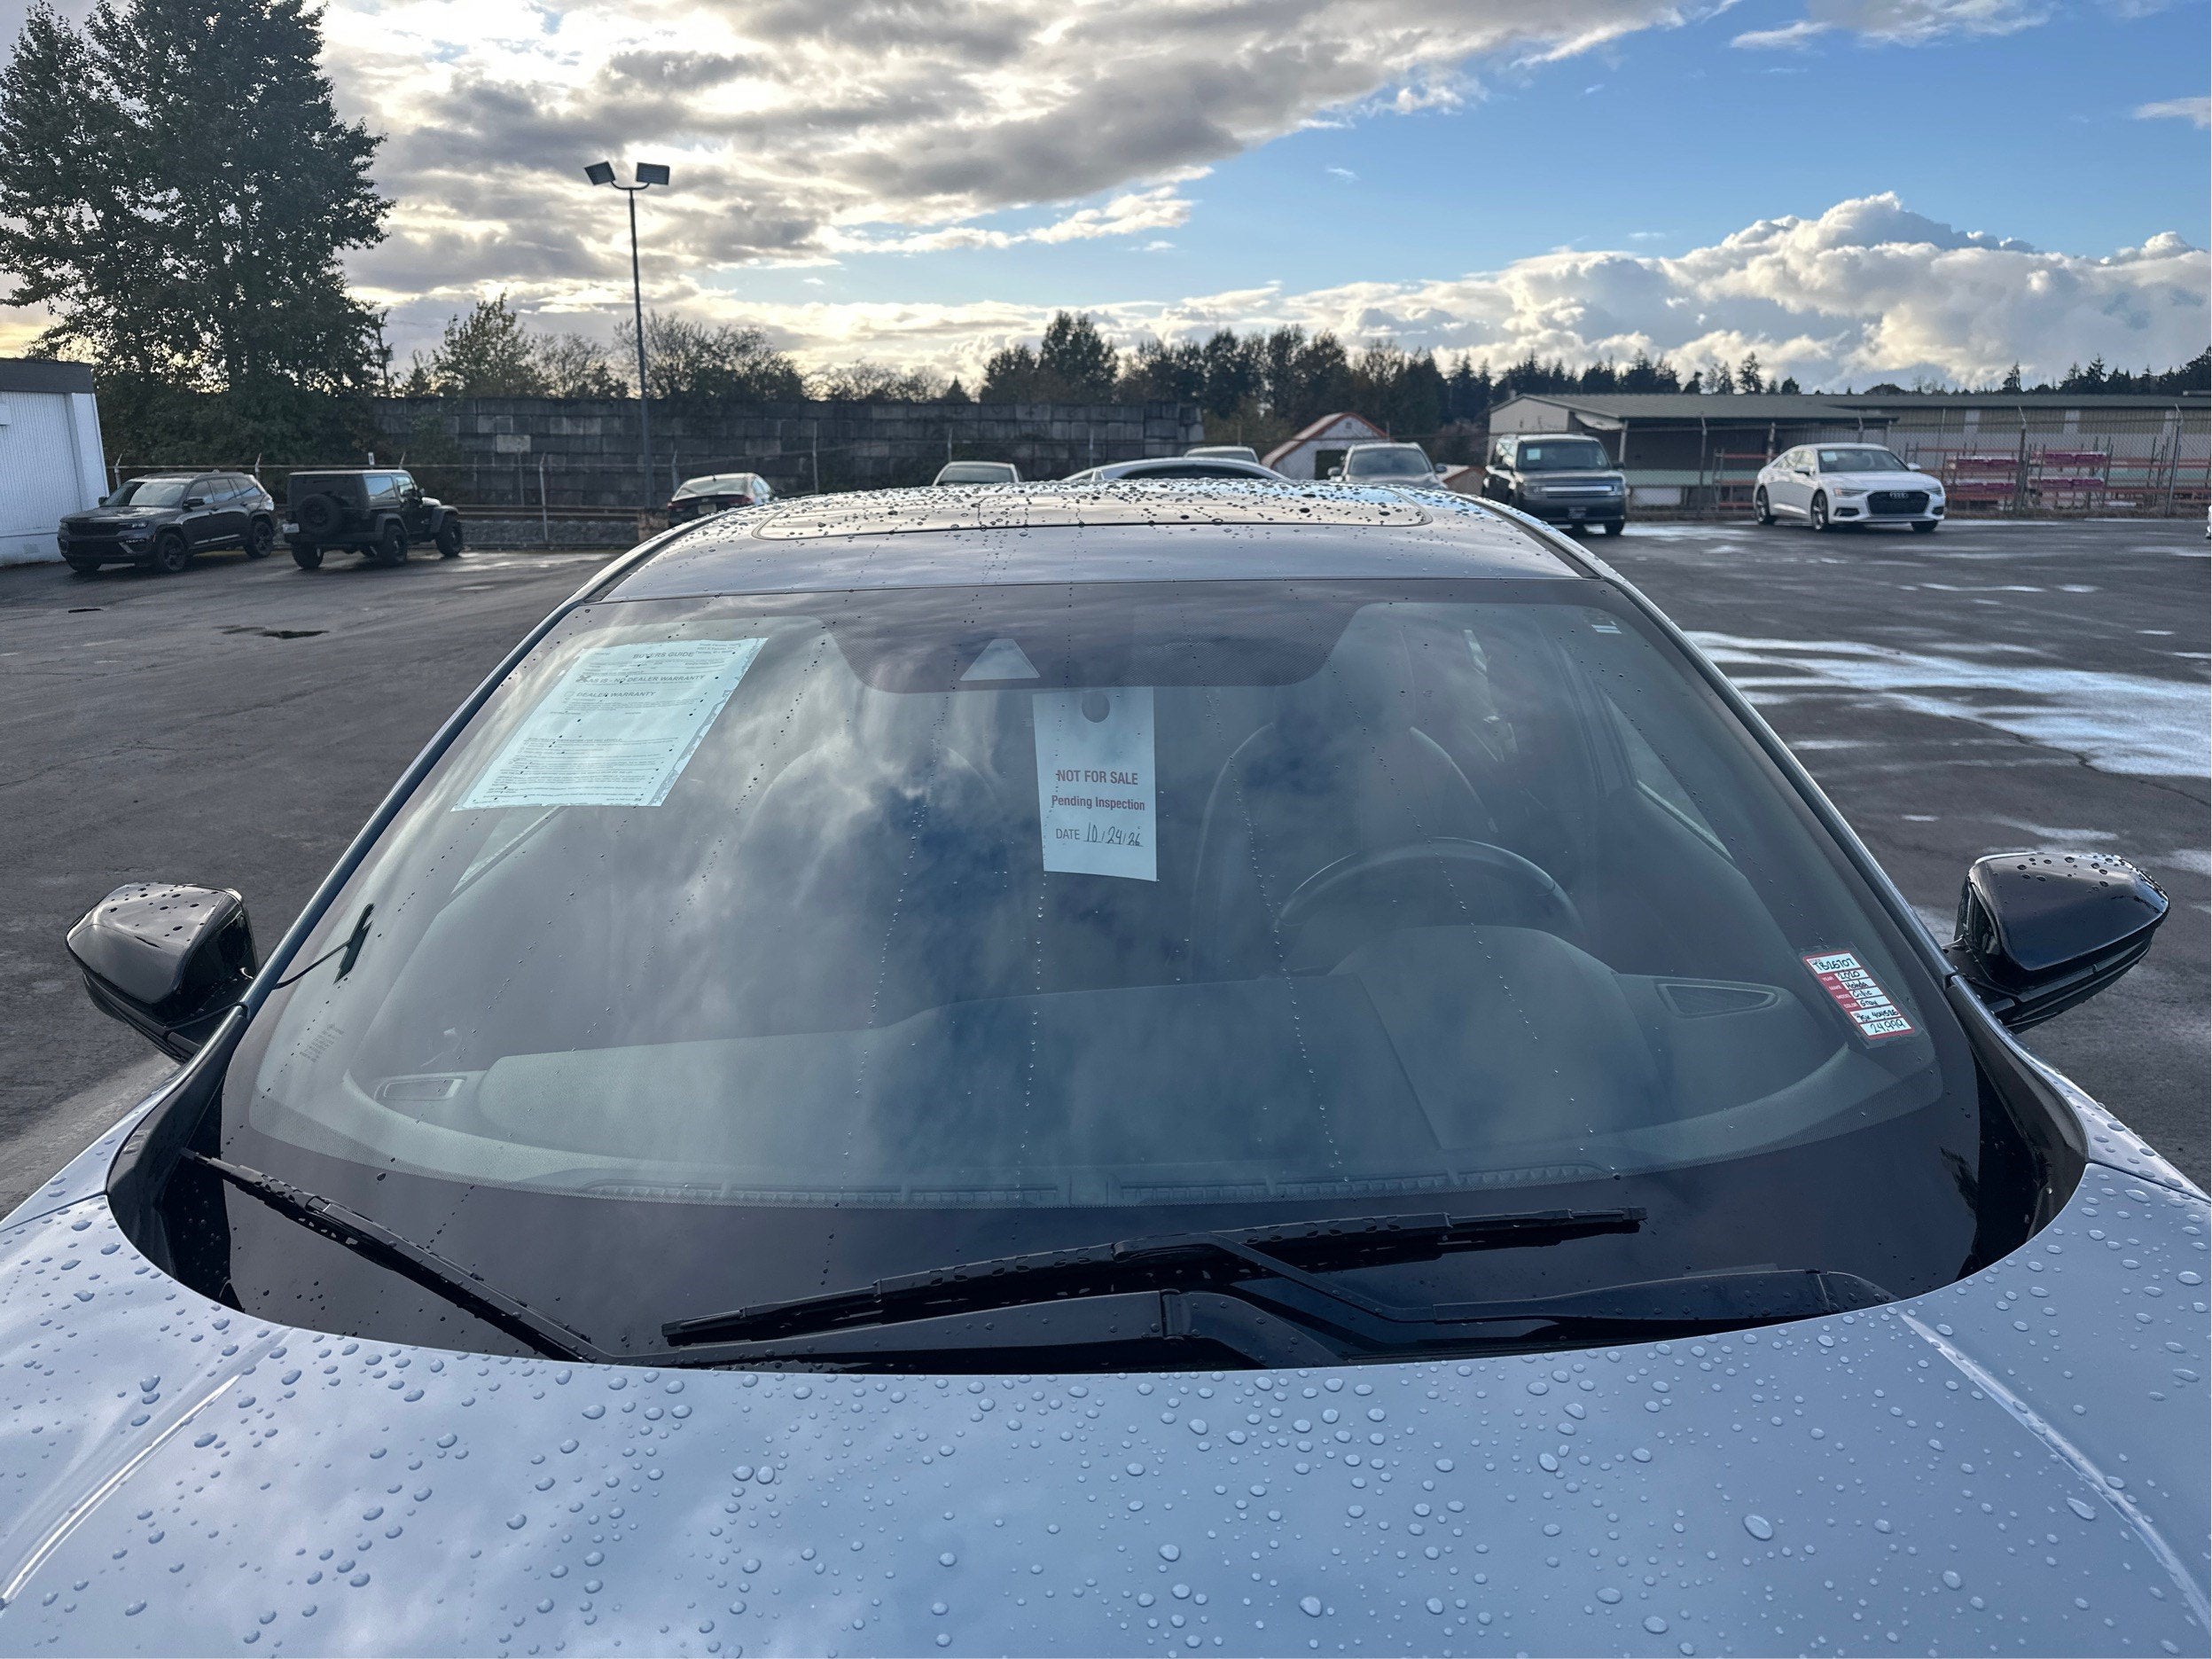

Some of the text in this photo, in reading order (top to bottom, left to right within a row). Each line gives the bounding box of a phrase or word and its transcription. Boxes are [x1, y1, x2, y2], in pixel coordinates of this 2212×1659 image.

[1057, 770, 1138, 786] NOT FOR SALE
[1051, 794, 1145, 811] Pending Inspection
[1055, 828, 1081, 841] DATE
[1852, 990, 1872, 998] Civic
